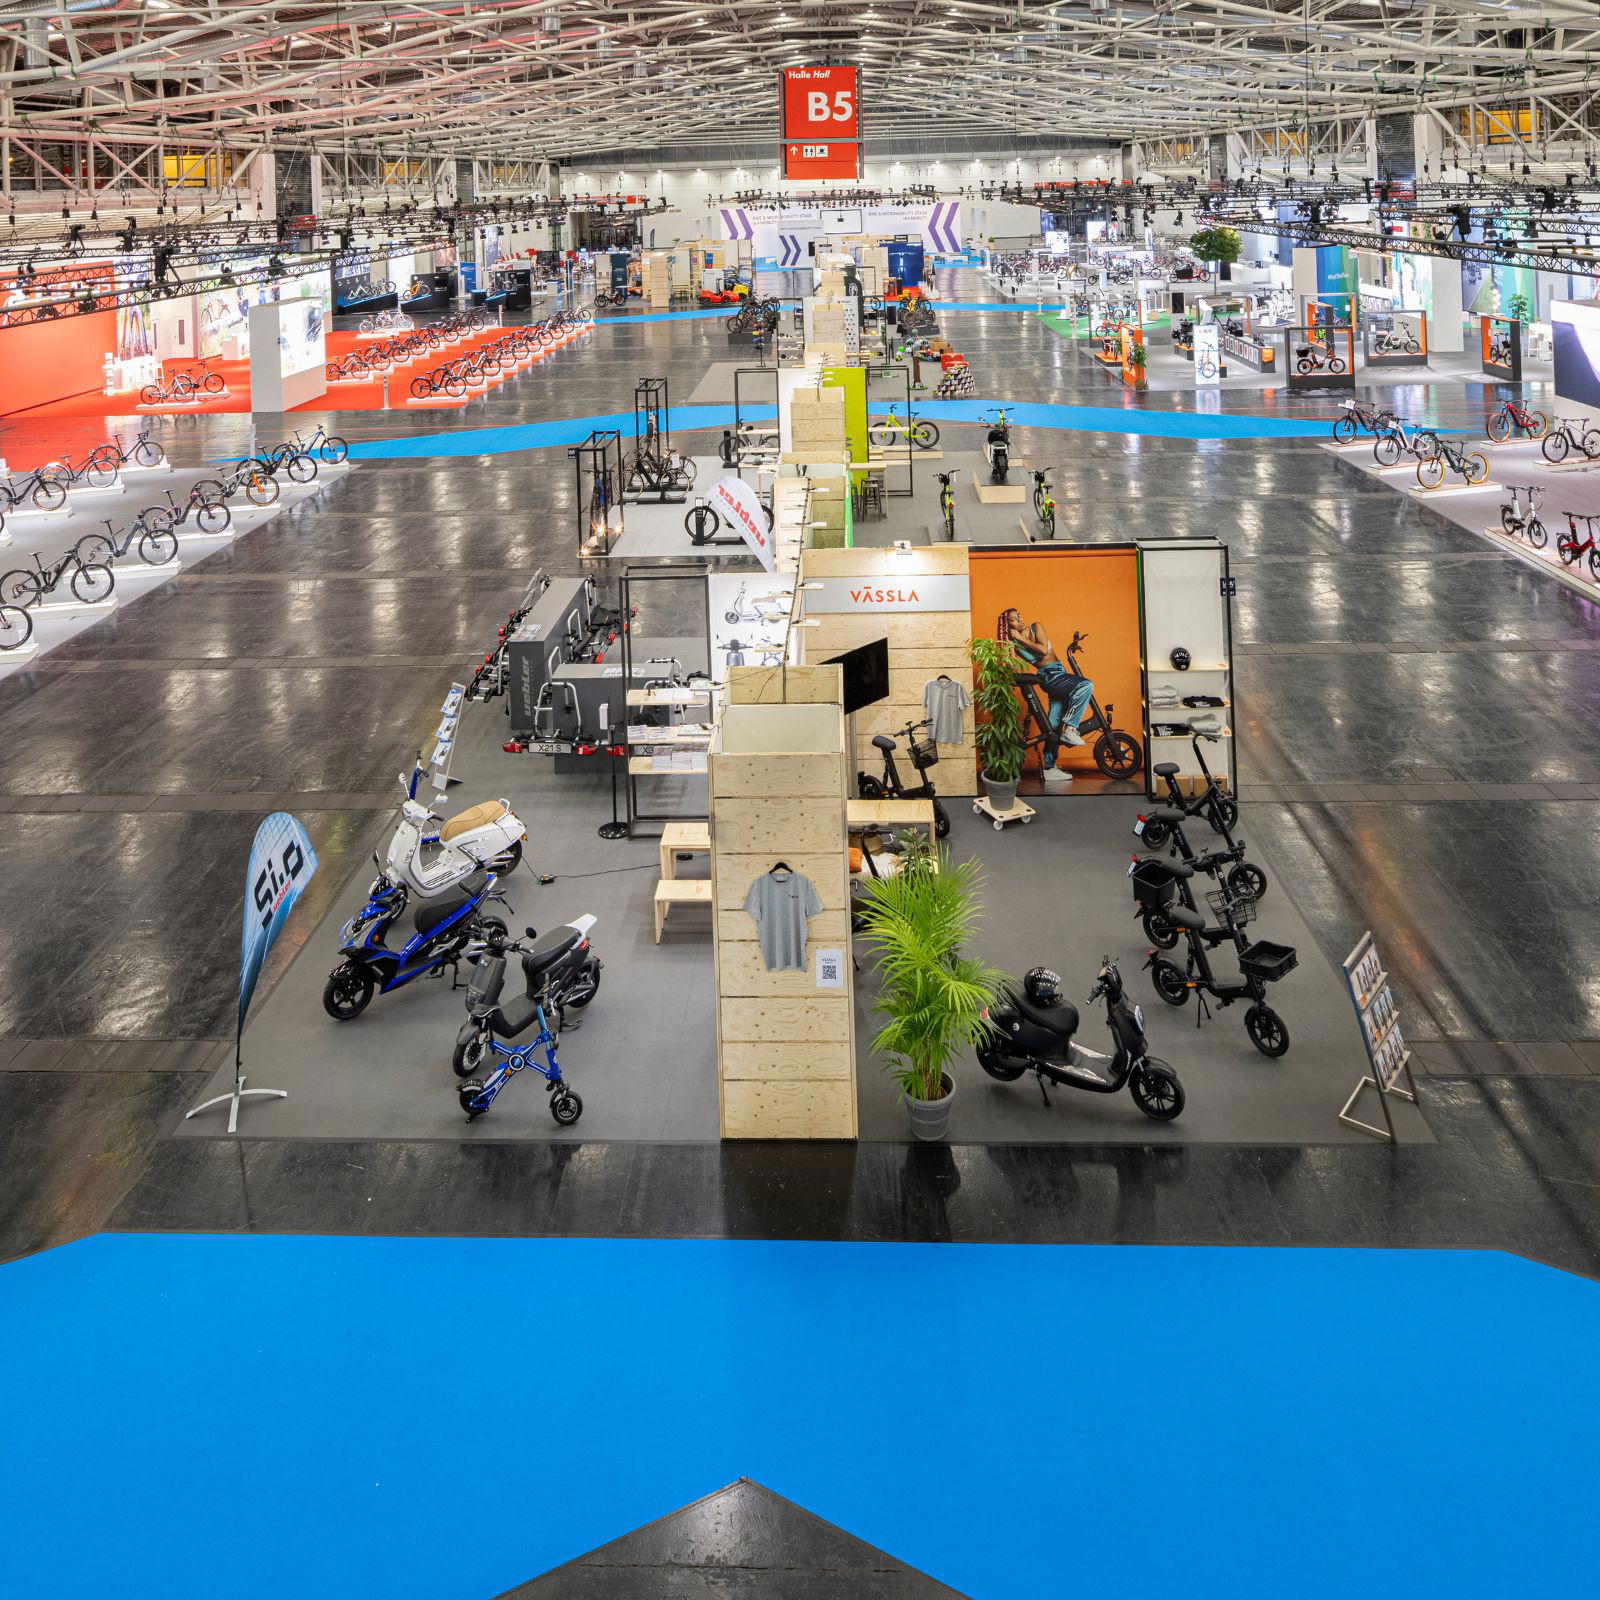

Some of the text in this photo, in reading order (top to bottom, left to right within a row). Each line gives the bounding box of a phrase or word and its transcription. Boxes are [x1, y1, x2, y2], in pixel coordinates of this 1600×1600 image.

[788, 70, 831, 79] Halle Hall
[807, 91, 853, 122] B5
[521, 655, 531, 717] uebler
